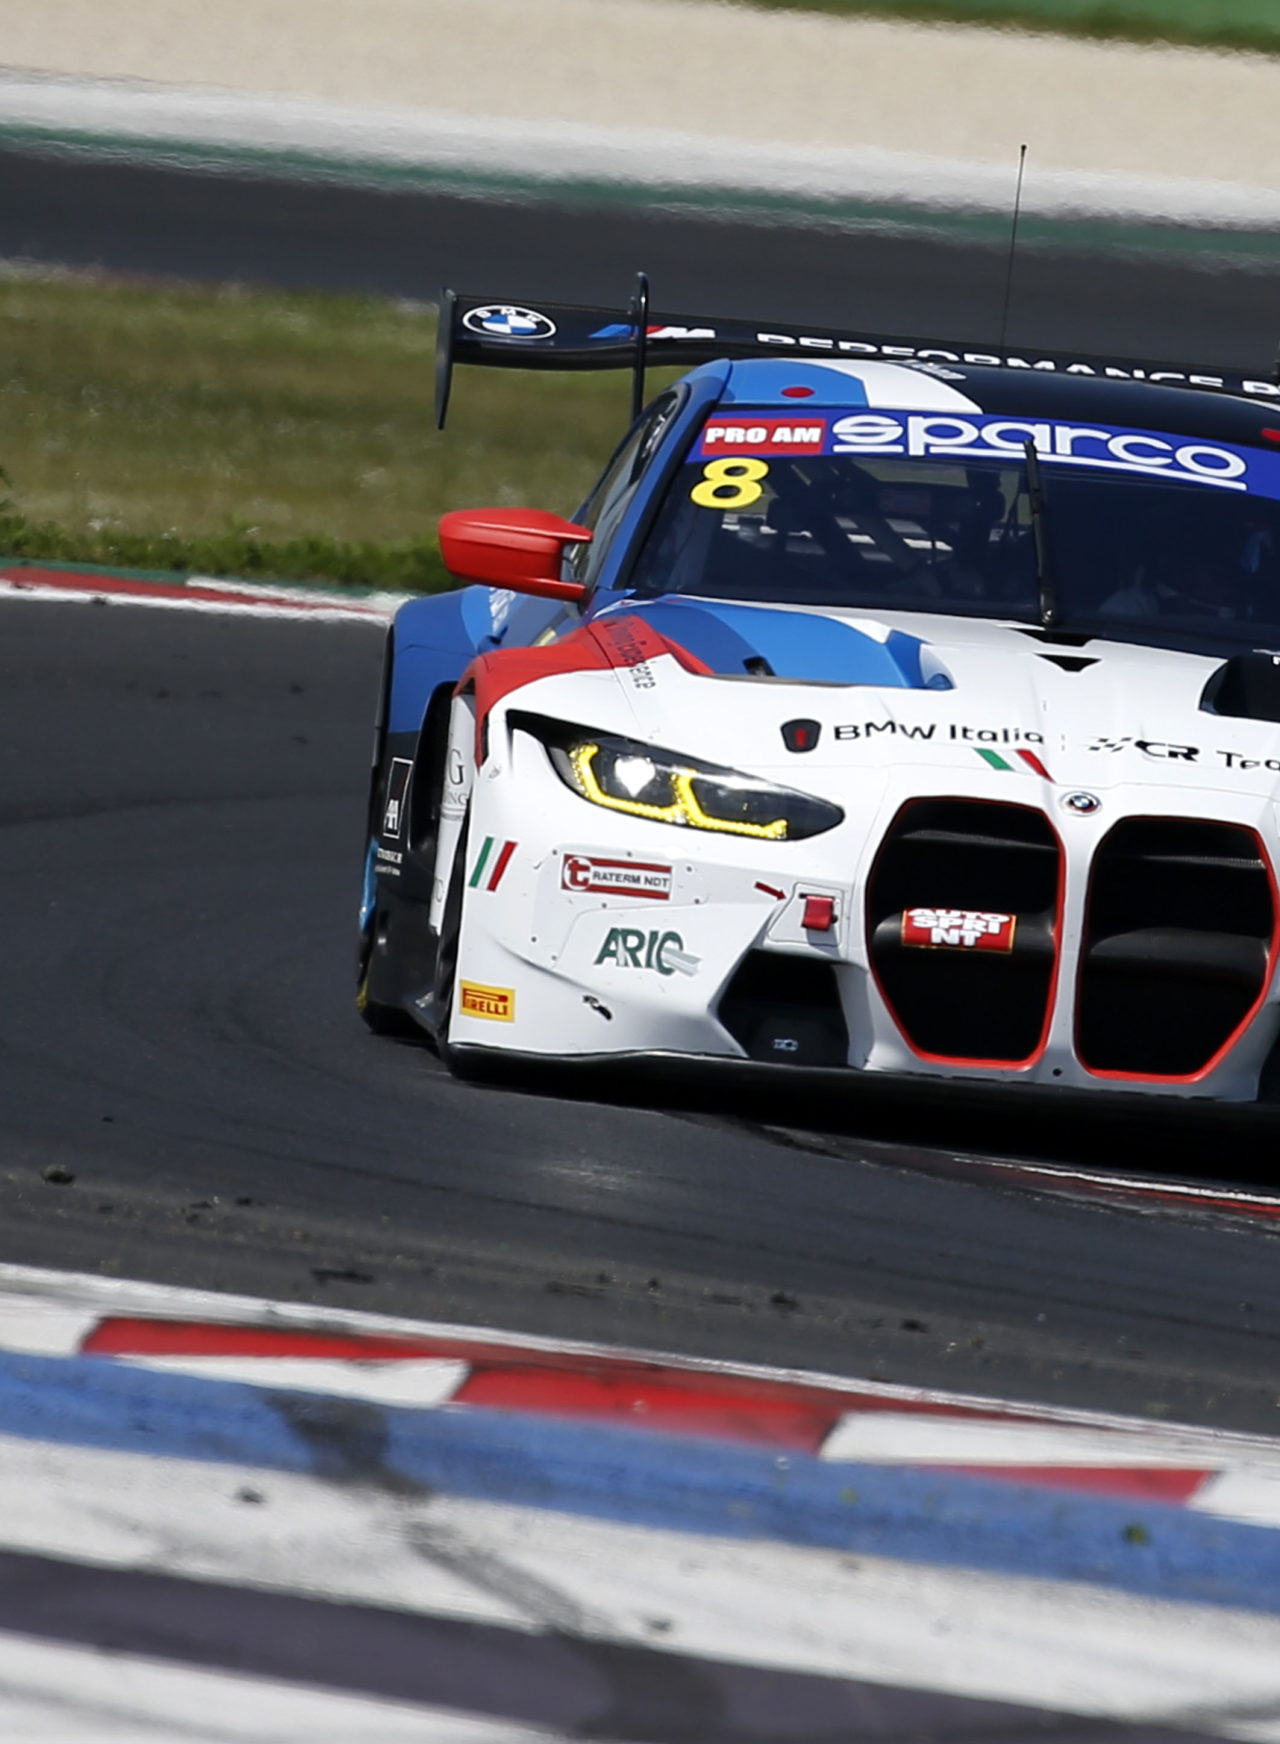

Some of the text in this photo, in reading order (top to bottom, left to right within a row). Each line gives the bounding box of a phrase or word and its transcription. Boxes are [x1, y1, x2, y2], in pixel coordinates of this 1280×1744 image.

[705, 426, 822, 443] PRO AM
[832, 414, 1247, 482] sparco
[690, 457, 769, 509] 8
[834, 719, 937, 741] BMW
[949, 723, 1044, 745] Italia
[644, 877, 670, 888] NDT
[930, 927, 983, 948] NT
[462, 988, 509, 1016] PIRELLI
